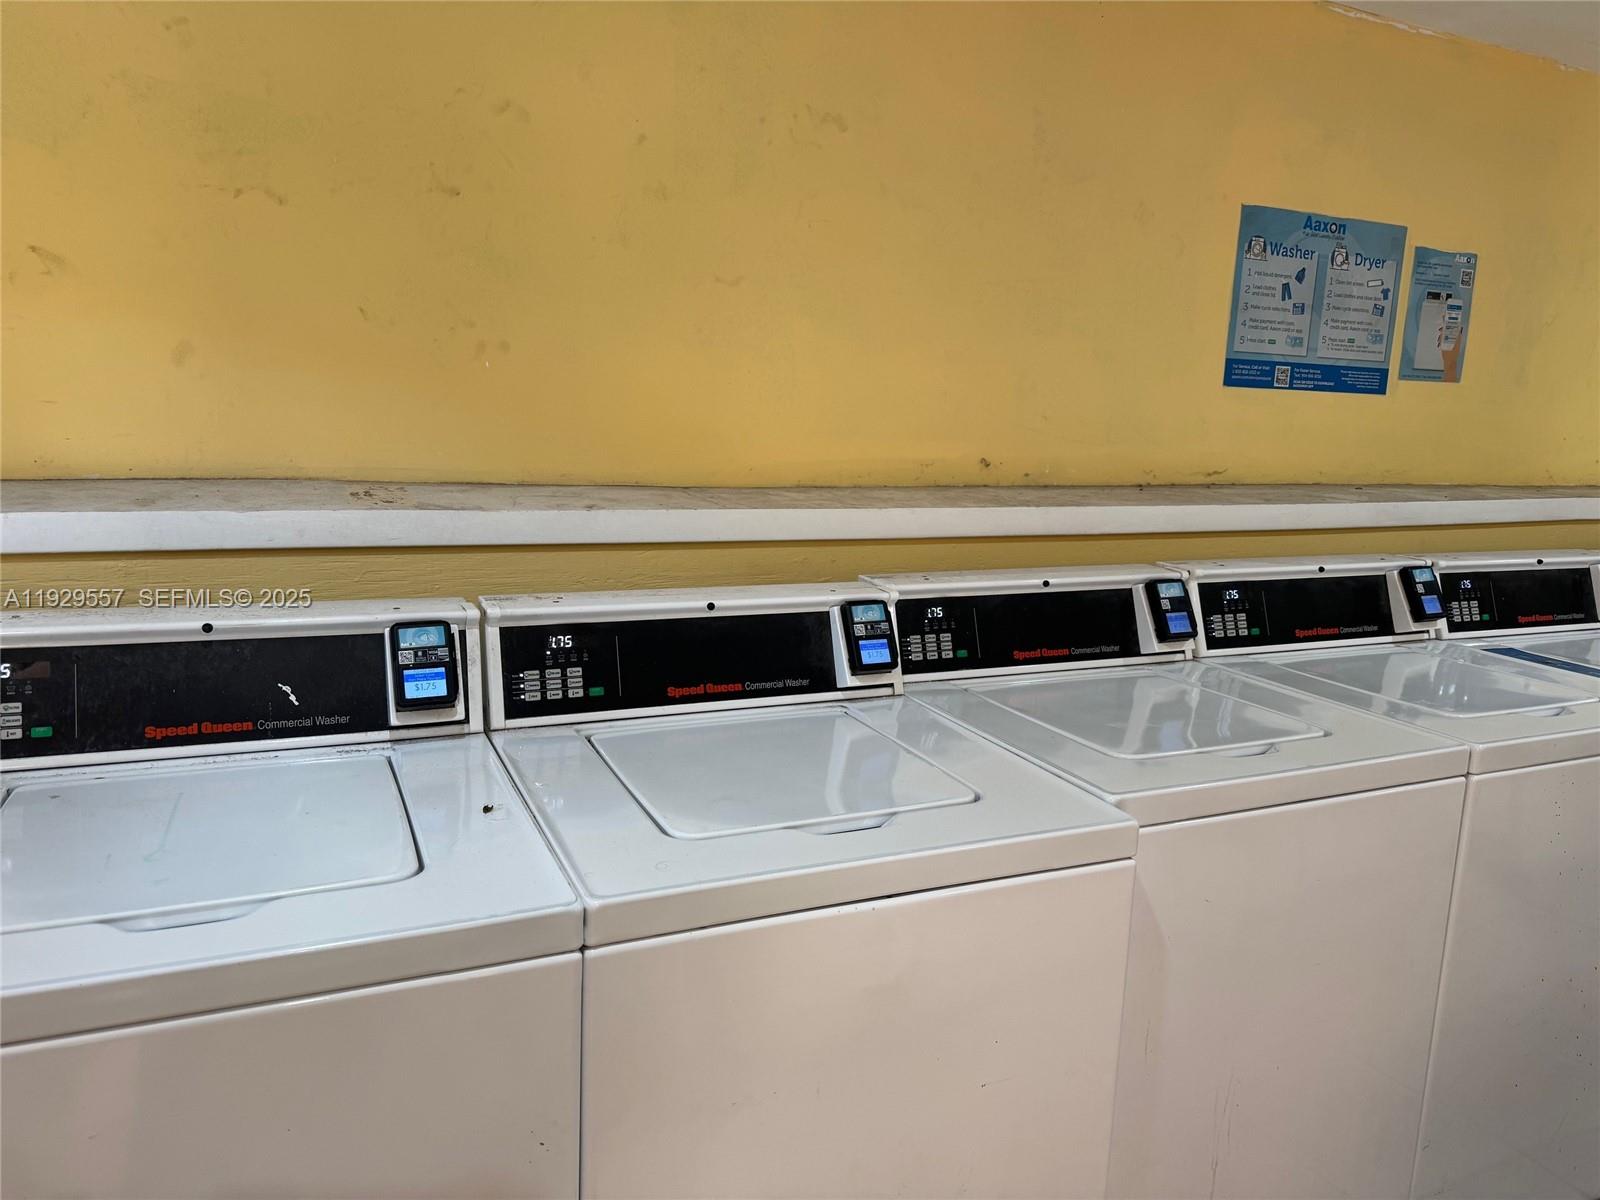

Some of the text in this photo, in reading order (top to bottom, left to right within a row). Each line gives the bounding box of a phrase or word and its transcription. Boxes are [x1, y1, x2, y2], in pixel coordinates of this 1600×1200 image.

[1303, 215, 1347, 235] Aaxon
[1269, 241, 1316, 260] Washer
[1354, 252, 1387, 271] Dryer
[1455, 254, 1475, 264] Aaxon
[1247, 267, 1252, 277] 1
[1329, 276, 1333, 286] 1
[1244, 285, 1250, 294] 2
[1326, 289, 1332, 299] 2
[1242, 302, 1248, 311] 3
[1325, 302, 1331, 311] 3
[1323, 319, 1328, 327] 4
[1239, 335, 1245, 344] 5
[1321, 335, 1327, 345] 5
[1518, 614, 1536, 624] Speed
[1536, 613, 1553, 622] Queen
[1295, 628, 1317, 638] Speed
[1317, 626, 1339, 635] Queen
[1013, 645, 1120, 661] Speed Queen Commercial Washer
[414, 681, 437, 692] $1.75
[667, 678, 810, 698] Speed Queen Commercial Washer
[144, 715, 351, 740] Speed Queen Commercial Washer
